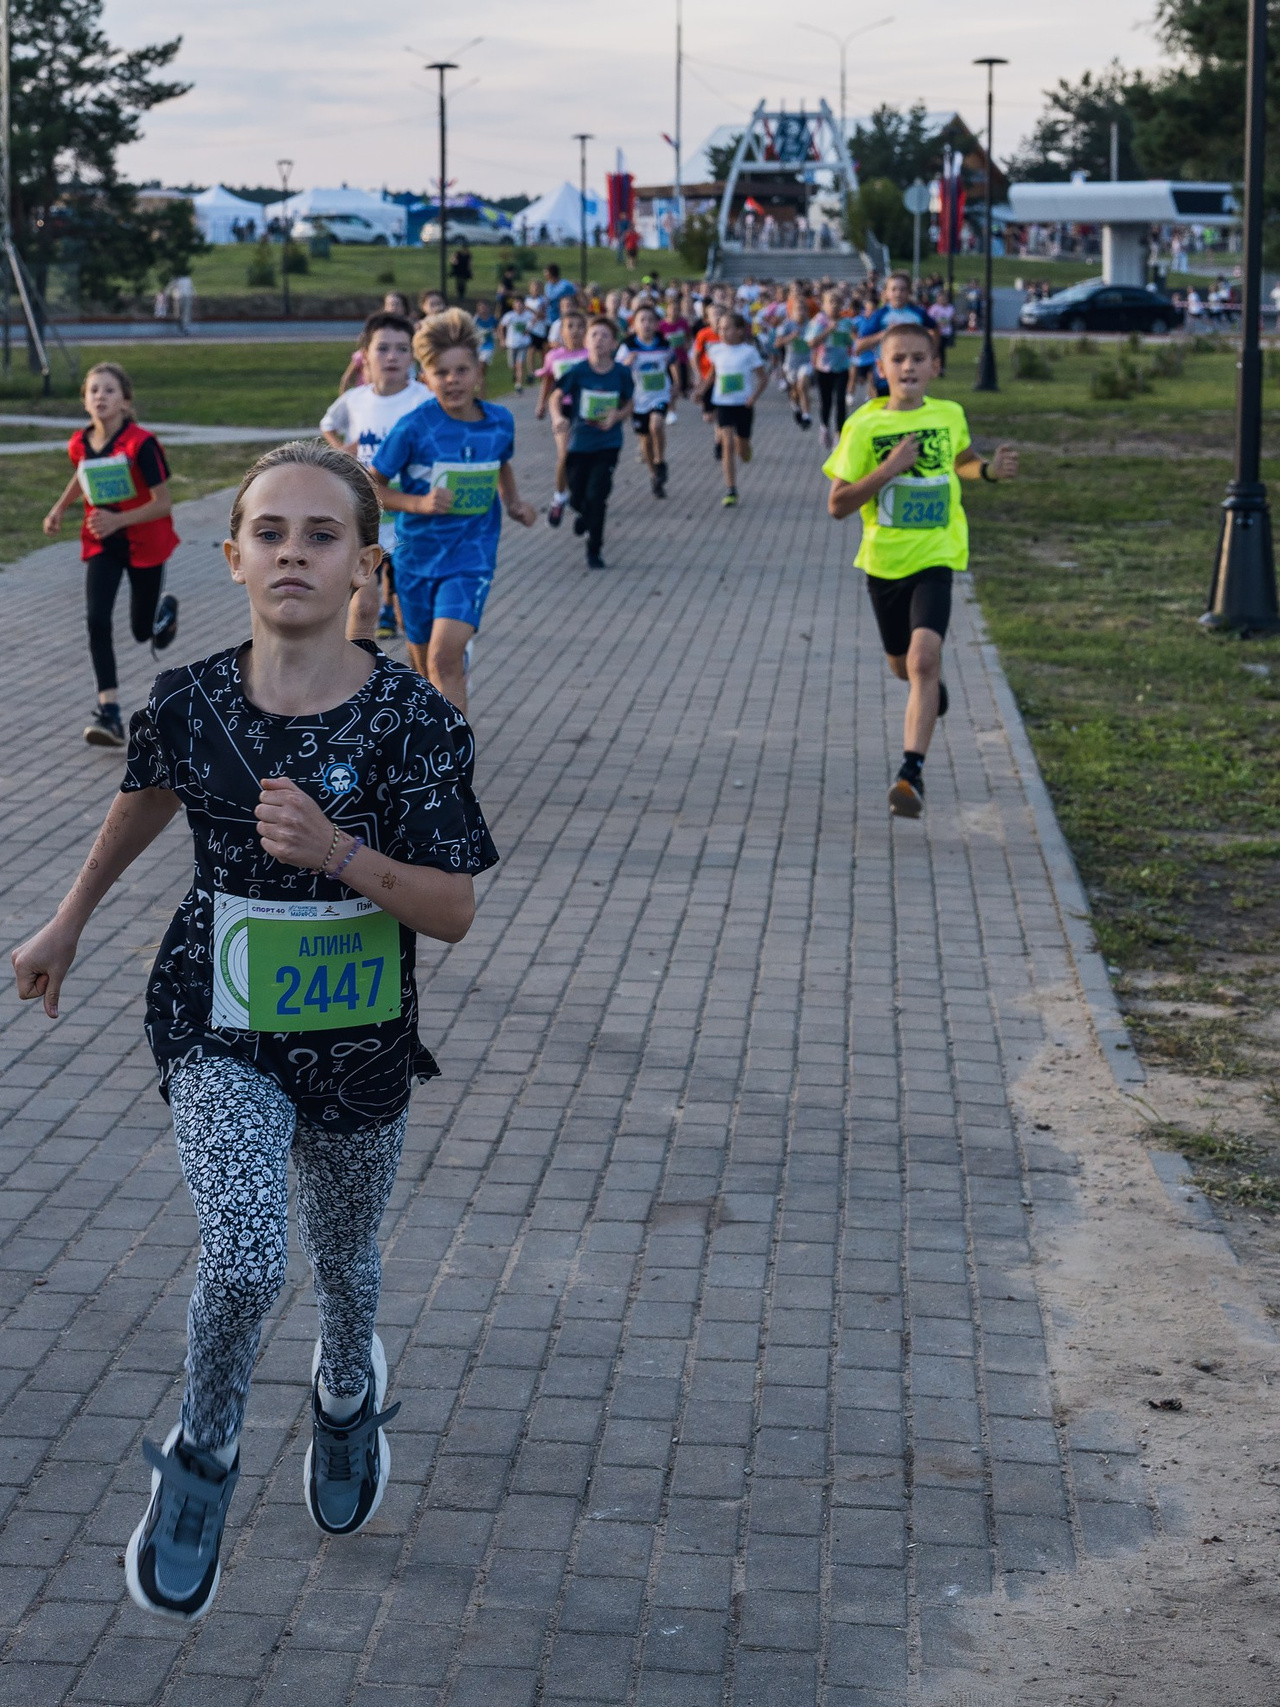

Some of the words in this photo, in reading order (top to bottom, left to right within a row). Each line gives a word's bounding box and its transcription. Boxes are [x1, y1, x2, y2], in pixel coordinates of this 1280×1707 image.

[902, 501, 945, 522] 2342
[251, 906, 275, 914] СПОРТ
[356, 900, 373, 912] Пэй
[299, 932, 363, 957] АЛИНА
[276, 956, 384, 1016] 2447
